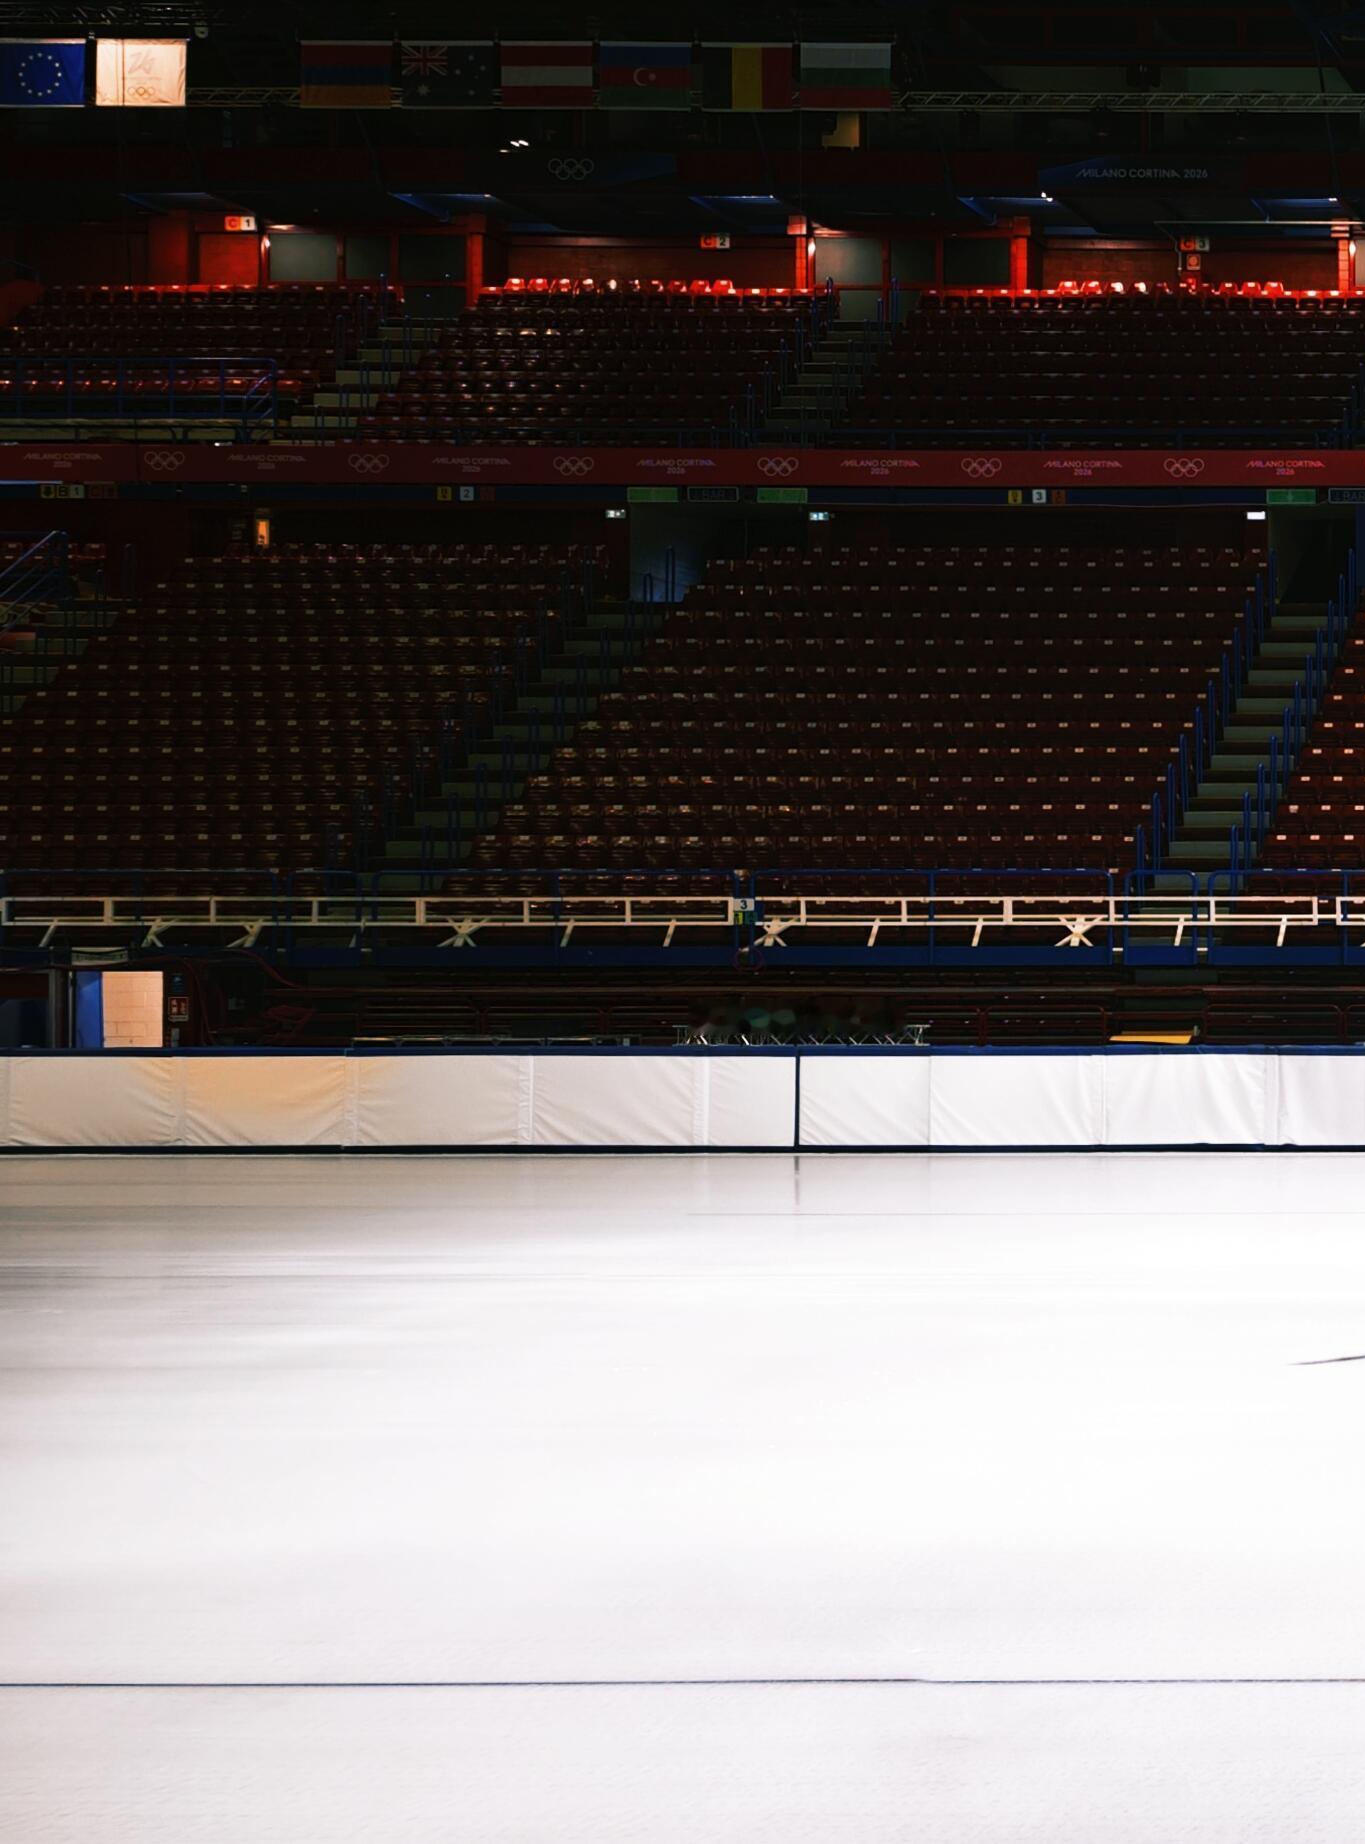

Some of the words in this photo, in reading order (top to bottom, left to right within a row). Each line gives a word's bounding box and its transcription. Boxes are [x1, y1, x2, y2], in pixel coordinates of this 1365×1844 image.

[1075, 168, 1127, 178] MILANO
[1128, 168, 1181, 178] CORTINA
[1183, 168, 1208, 178] 2026
[24, 453, 62, 461] MILANO
[63, 453, 103, 461] CORTINA
[228, 454, 265, 462] MILANO
[266, 454, 306, 462] CORTINA
[1247, 460, 1284, 468] MILANO
[1285, 460, 1325, 468] CORTINA
